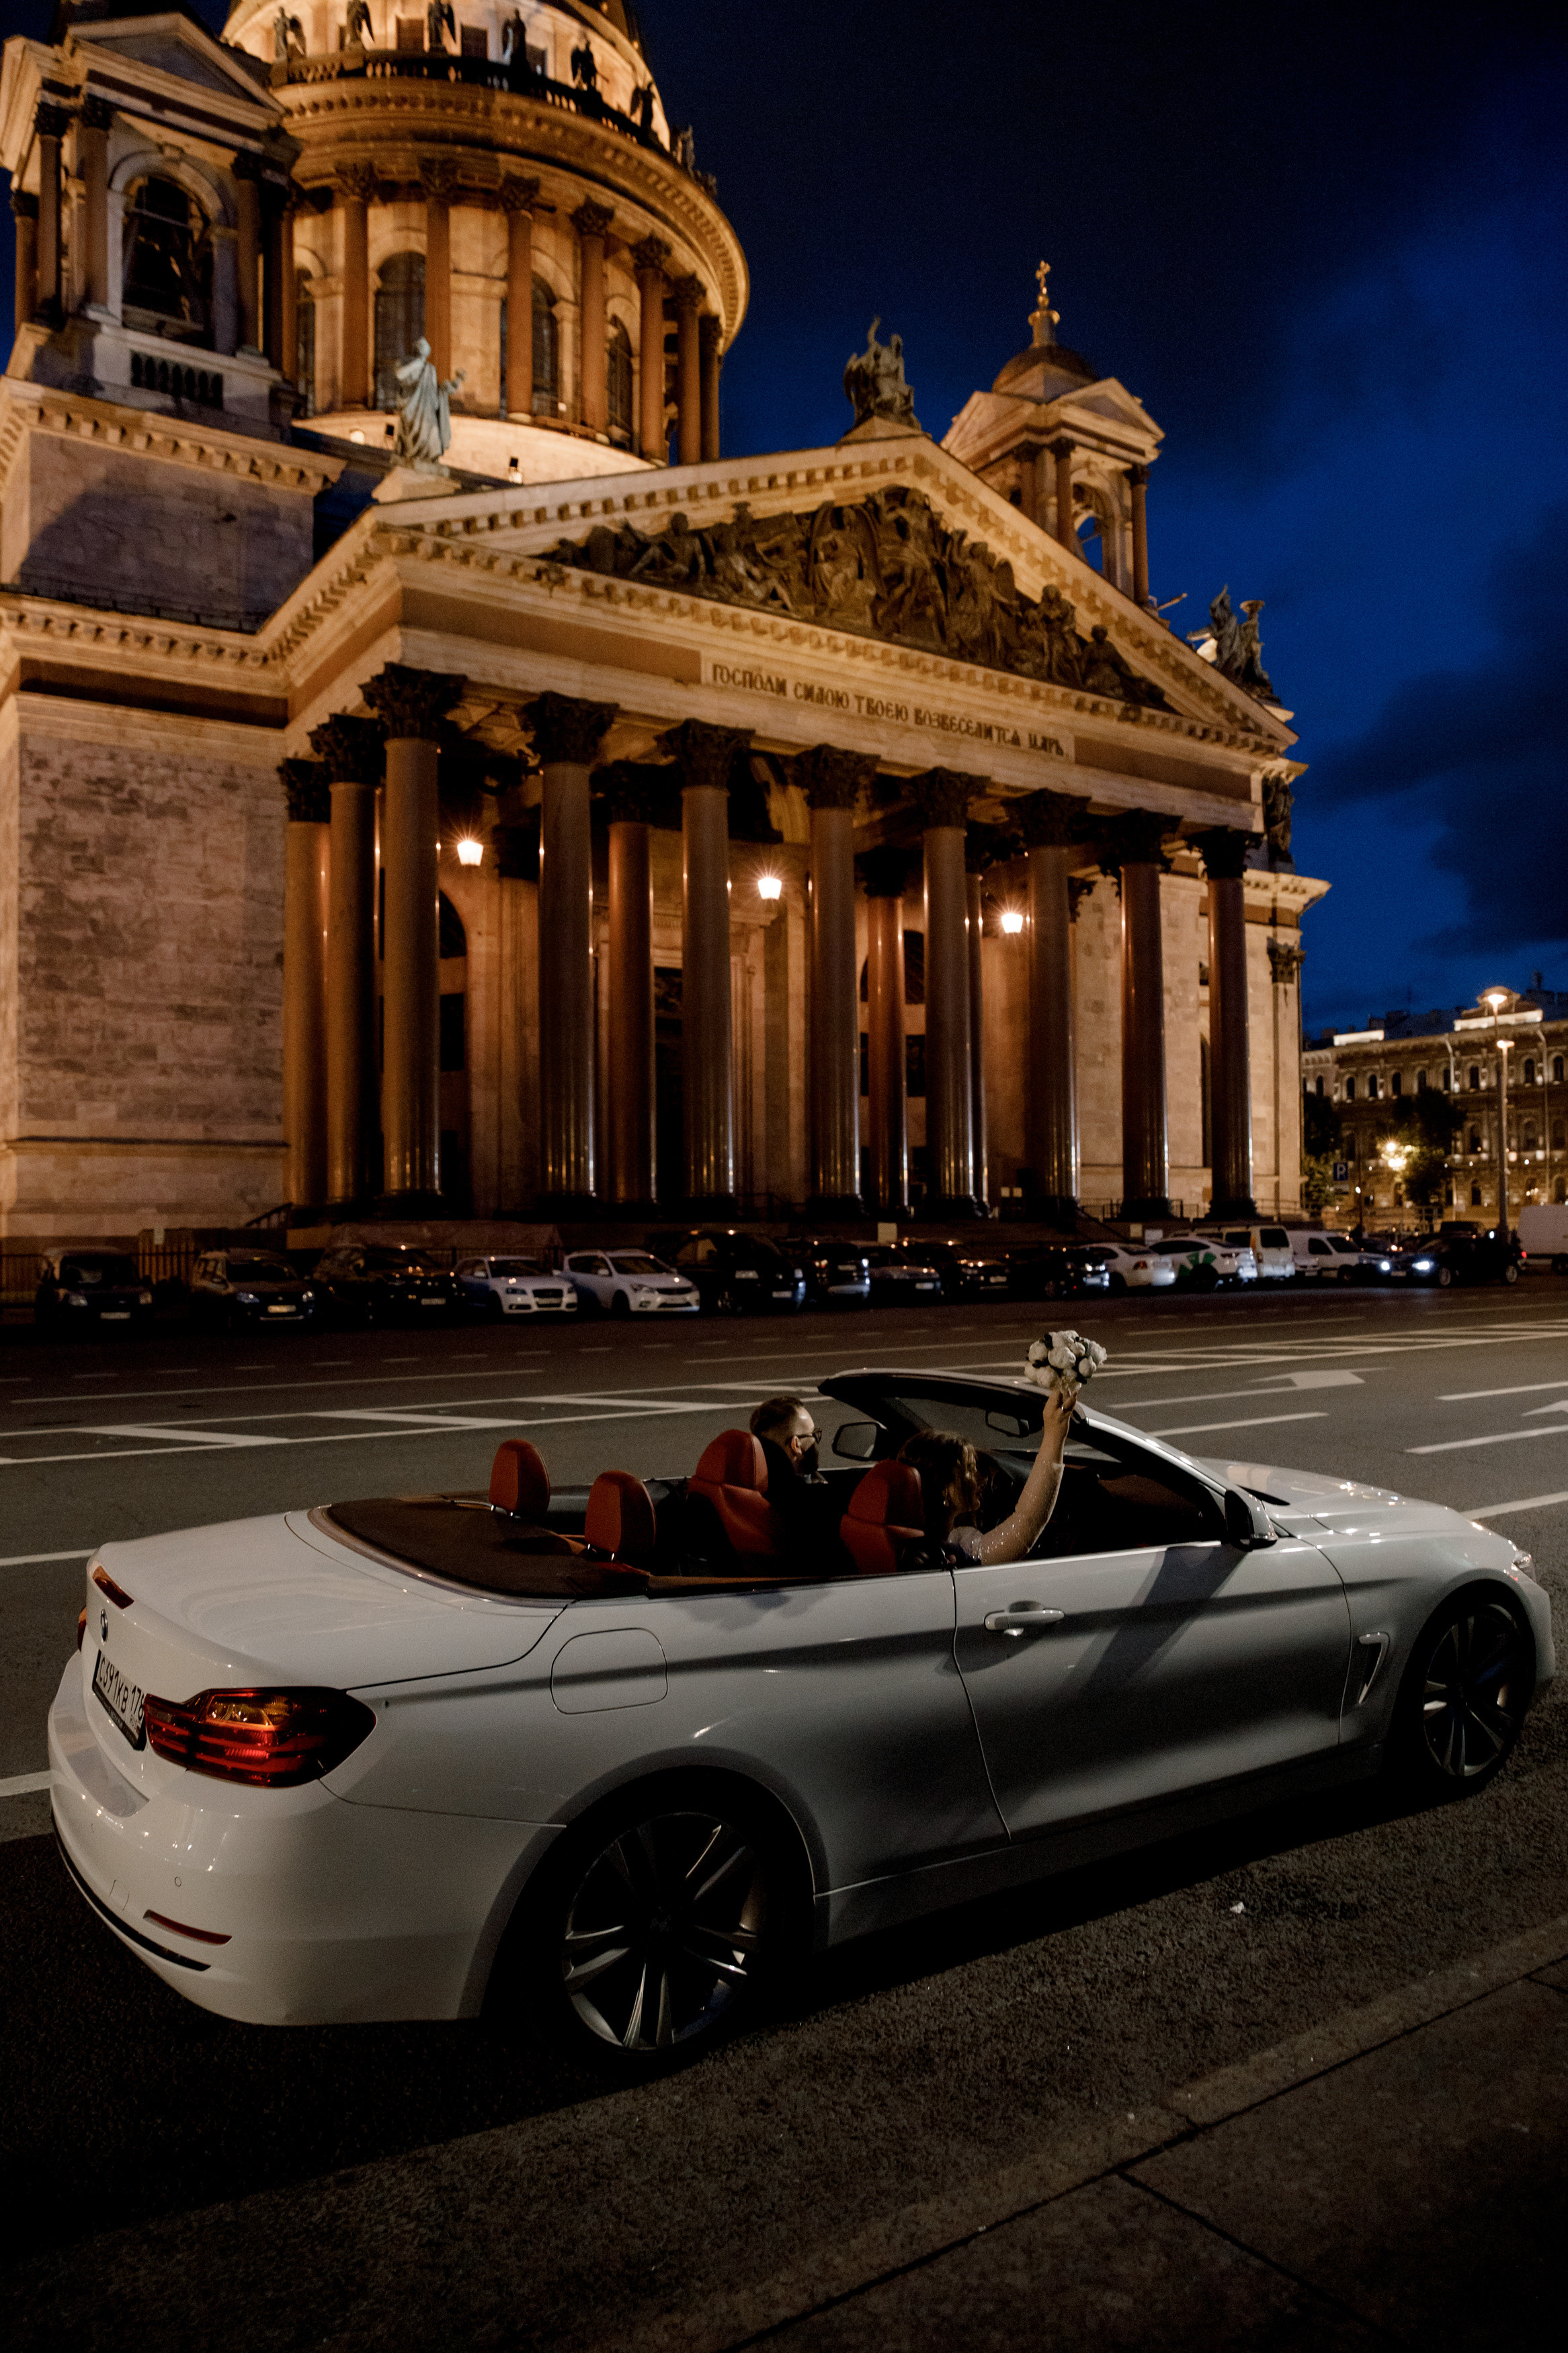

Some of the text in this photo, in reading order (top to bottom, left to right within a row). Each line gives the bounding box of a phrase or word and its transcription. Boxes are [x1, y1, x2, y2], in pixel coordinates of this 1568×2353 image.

[712, 664, 786, 696] ГОСПОДИ
[793, 682, 850, 709] СИЛОЮ
[854, 694, 909, 722] ТВОЕЮ
